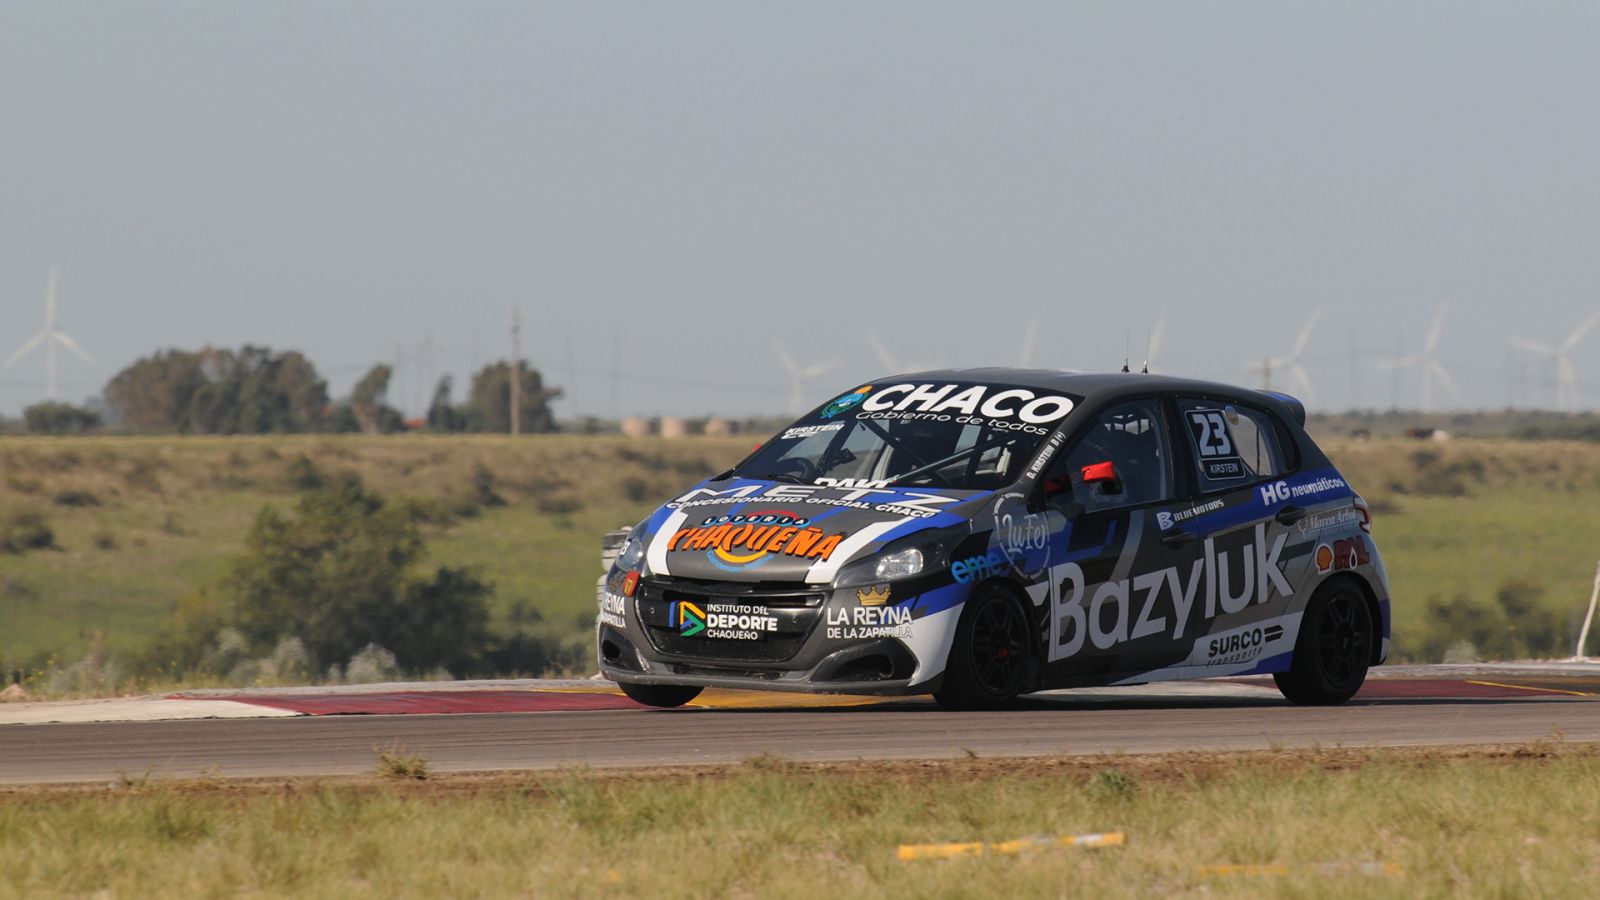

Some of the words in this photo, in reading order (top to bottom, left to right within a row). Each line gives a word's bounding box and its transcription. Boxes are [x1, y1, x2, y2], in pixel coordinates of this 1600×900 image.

[862, 384, 1074, 424] CHACO
[785, 423, 845, 435] KIRSTEIN
[855, 410, 952, 423] Gobierno
[956, 415, 984, 425] de
[988, 418, 1049, 435] todos
[1191, 413, 1231, 456] 23
[1210, 463, 1239, 474] KIRSTEIN
[674, 485, 961, 513] METZ
[1260, 480, 1291, 506] HG
[1292, 477, 1345, 498] neumáticos
[665, 496, 803, 509] CONCESIONARIO
[805, 498, 871, 510] OFICIAL
[875, 503, 938, 518] CHACO
[703, 514, 809, 526] LOTERIA
[667, 523, 844, 561] CHAQUEÑA
[1048, 522, 1294, 663] Bazyluk
[707, 603, 751, 615] INSTITUTO
[752, 606, 769, 616] DEL
[827, 607, 850, 625] LA
[853, 606, 913, 625] REYNA
[707, 615, 778, 632] DEPORTE
[707, 629, 758, 640] CHAQUEÑO
[827, 628, 842, 639] DE
[844, 628, 858, 638] LA
[859, 627, 913, 639] ZAPATILLA
[1208, 628, 1262, 658] SURCO
